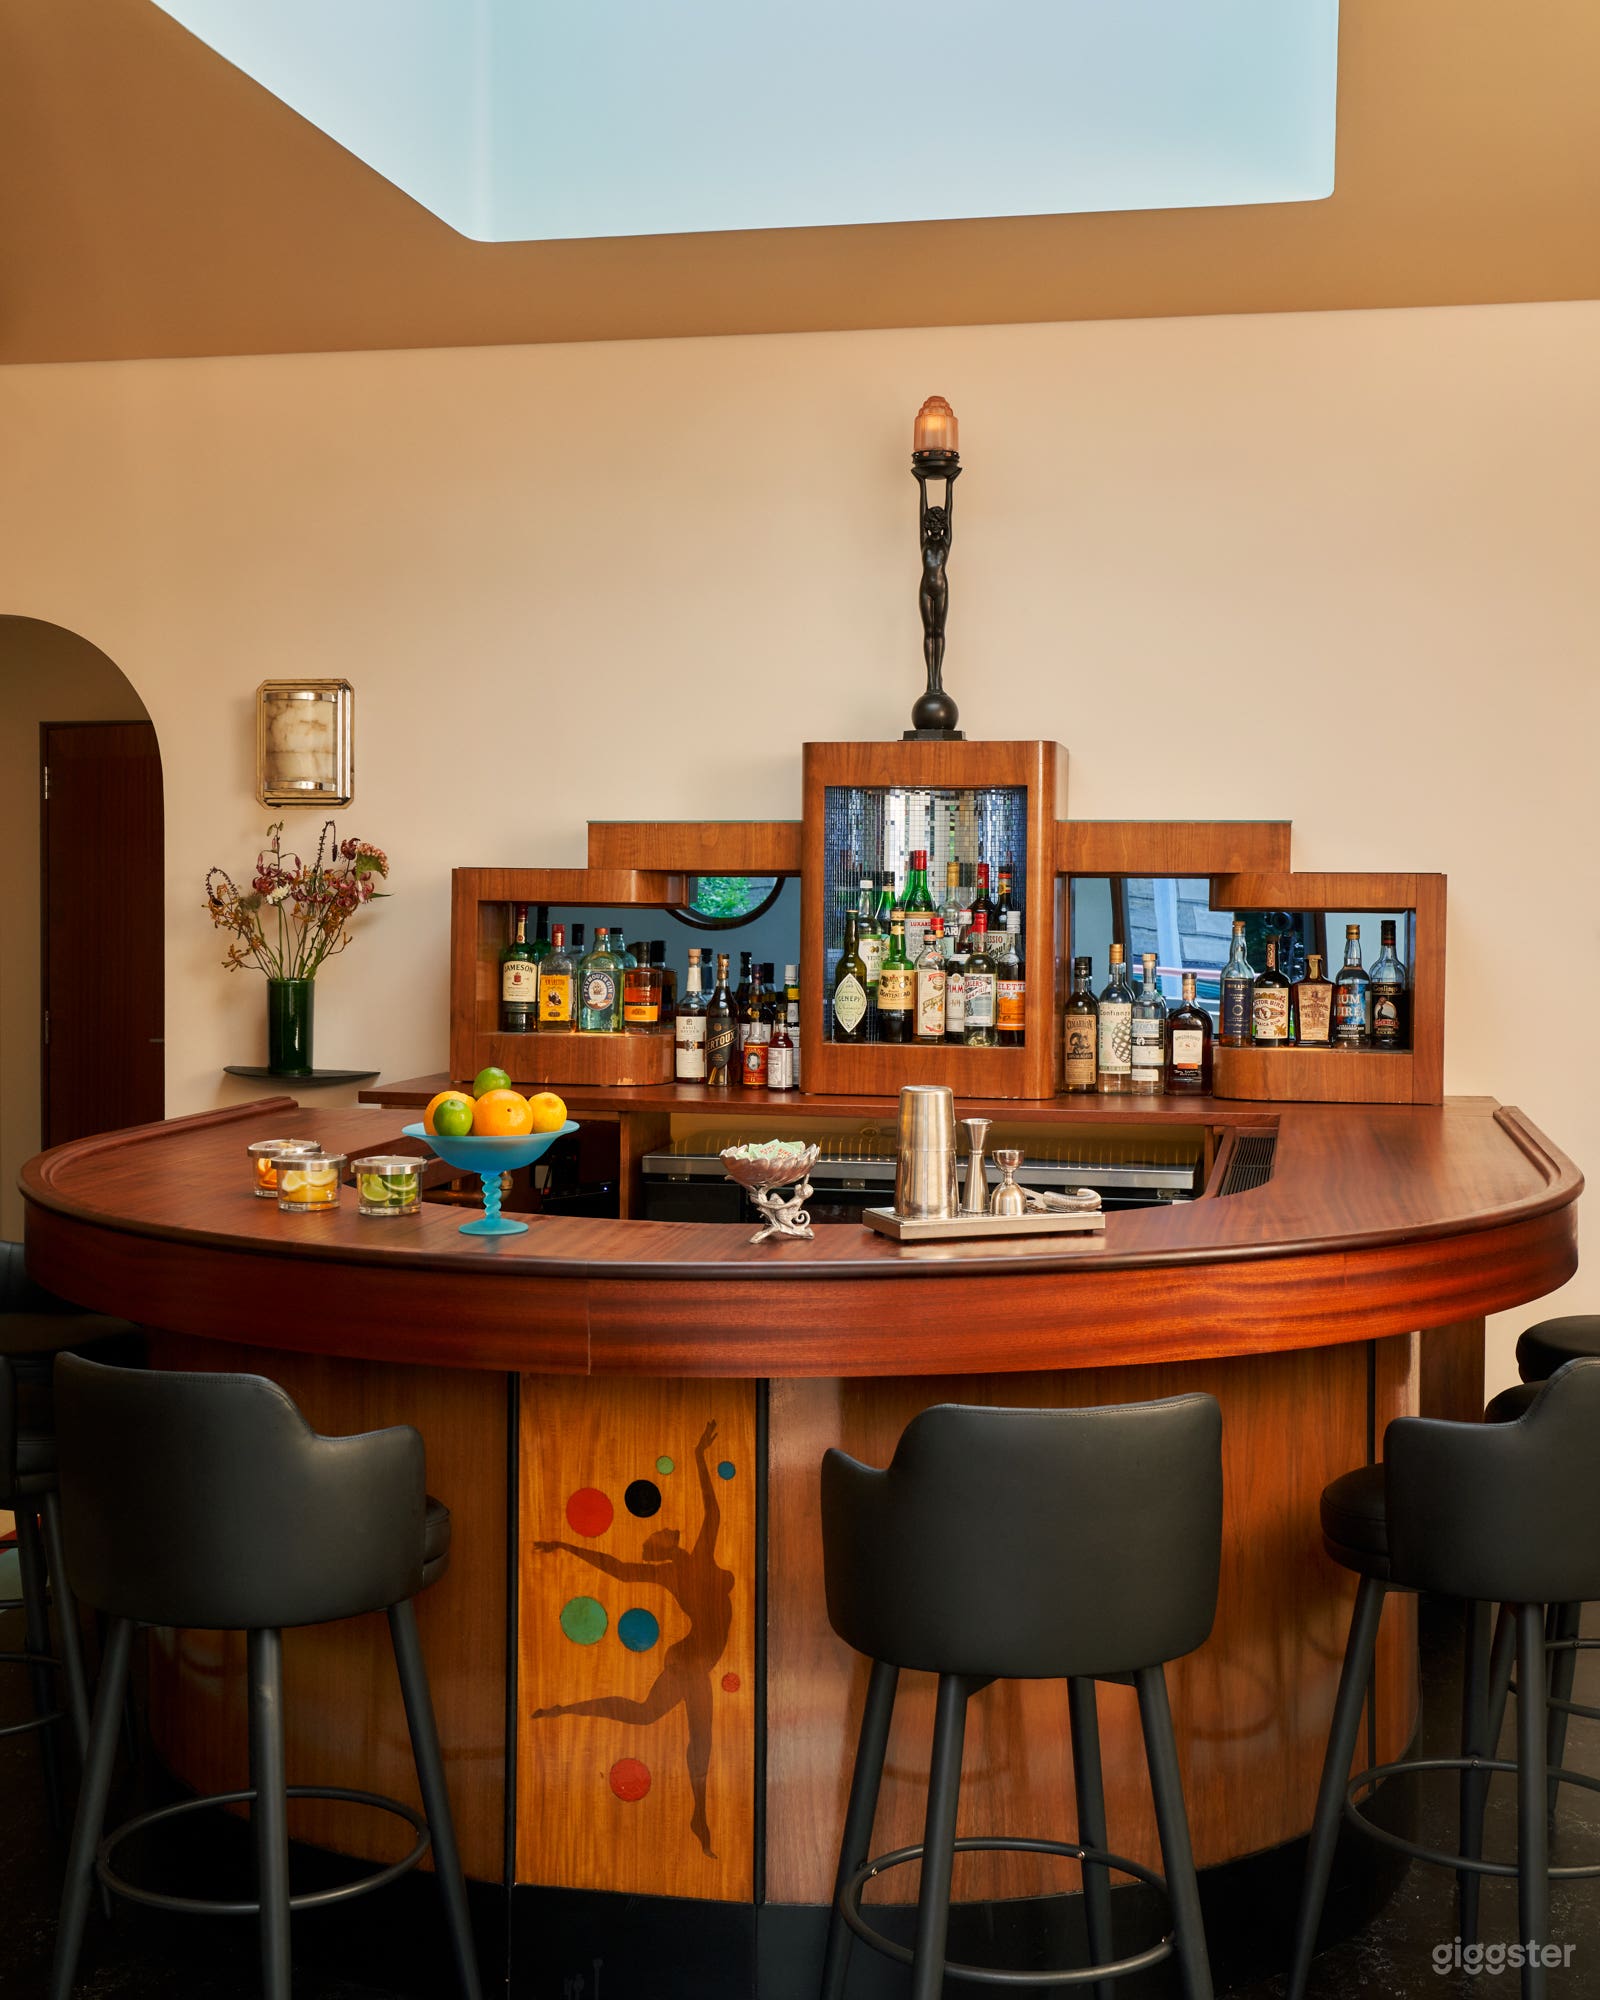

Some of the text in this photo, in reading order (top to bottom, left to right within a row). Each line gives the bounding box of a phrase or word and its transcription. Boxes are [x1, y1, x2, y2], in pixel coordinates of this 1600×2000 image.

[504, 964, 534, 974] JAMESON
[583, 973, 609, 993] PLYMOUTH
[997, 983, 1026, 991] ELETTI
[1270, 1000, 1285, 1009] BIRD
